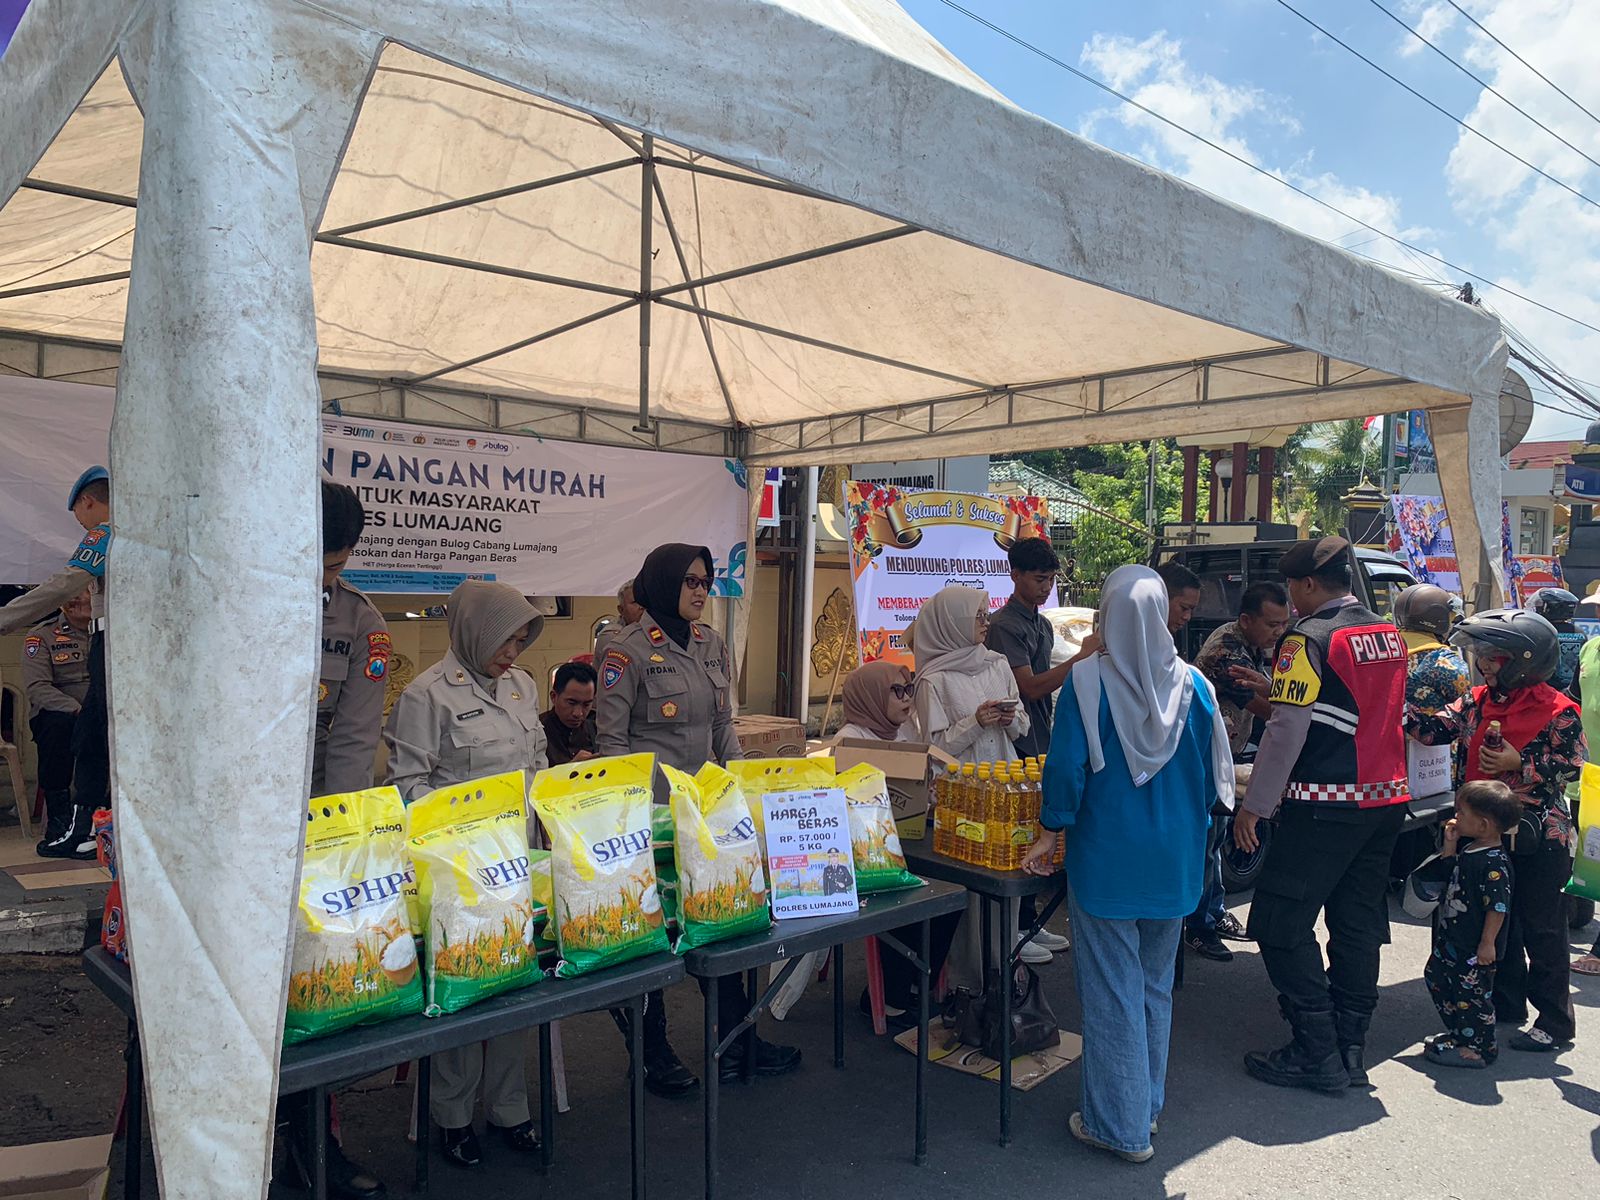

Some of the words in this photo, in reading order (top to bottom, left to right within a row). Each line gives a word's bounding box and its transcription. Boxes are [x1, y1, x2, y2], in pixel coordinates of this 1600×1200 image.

[483, 441, 509, 453] bulog
[350, 449, 490, 490] PANGAN
[502, 465, 606, 499] MURAH
[346, 485, 403, 506] NTUK
[409, 490, 541, 514] MASYARAKAT
[904, 499, 952, 522] Selamat
[956, 500, 964, 518] &
[970, 502, 1005, 524] Sukses
[392, 511, 502, 533] LUMAJANG
[397, 537, 438, 549] dengan
[440, 538, 470, 550] Bulog
[472, 540, 511, 553] Cabang
[513, 541, 558, 554] Lumajang
[350, 549, 388, 558] asokan
[391, 549, 412, 559] dan
[414, 550, 446, 562] Harga
[449, 551, 487, 563] Pangan
[490, 553, 517, 562] Beras
[886, 556, 949, 575] MENDUKUNG
[951, 559, 985, 575] POLRES
[986, 559, 1011, 575] LUMA
[877, 596, 929, 610] MEMBERAN
[1349, 632, 1405, 663] POLISI
[646, 666, 677, 676] IRDANI
[1286, 680, 1309, 703] RW
[770, 806, 818, 821] HARGA
[370, 823, 403, 836] bulog
[798, 816, 839, 830] BERAS
[592, 828, 651, 863] SPHP
[779, 836, 796, 844] RP.
[799, 832, 831, 842] 57.000
[799, 843, 805, 851] 5
[808, 842, 823, 850] KG
[476, 855, 530, 887] SPHP
[321, 872, 404, 915] SPHP
[775, 904, 808, 913] POLRES
[809, 901, 854, 911] LUMAJANG
[776, 944, 786, 958] 4
